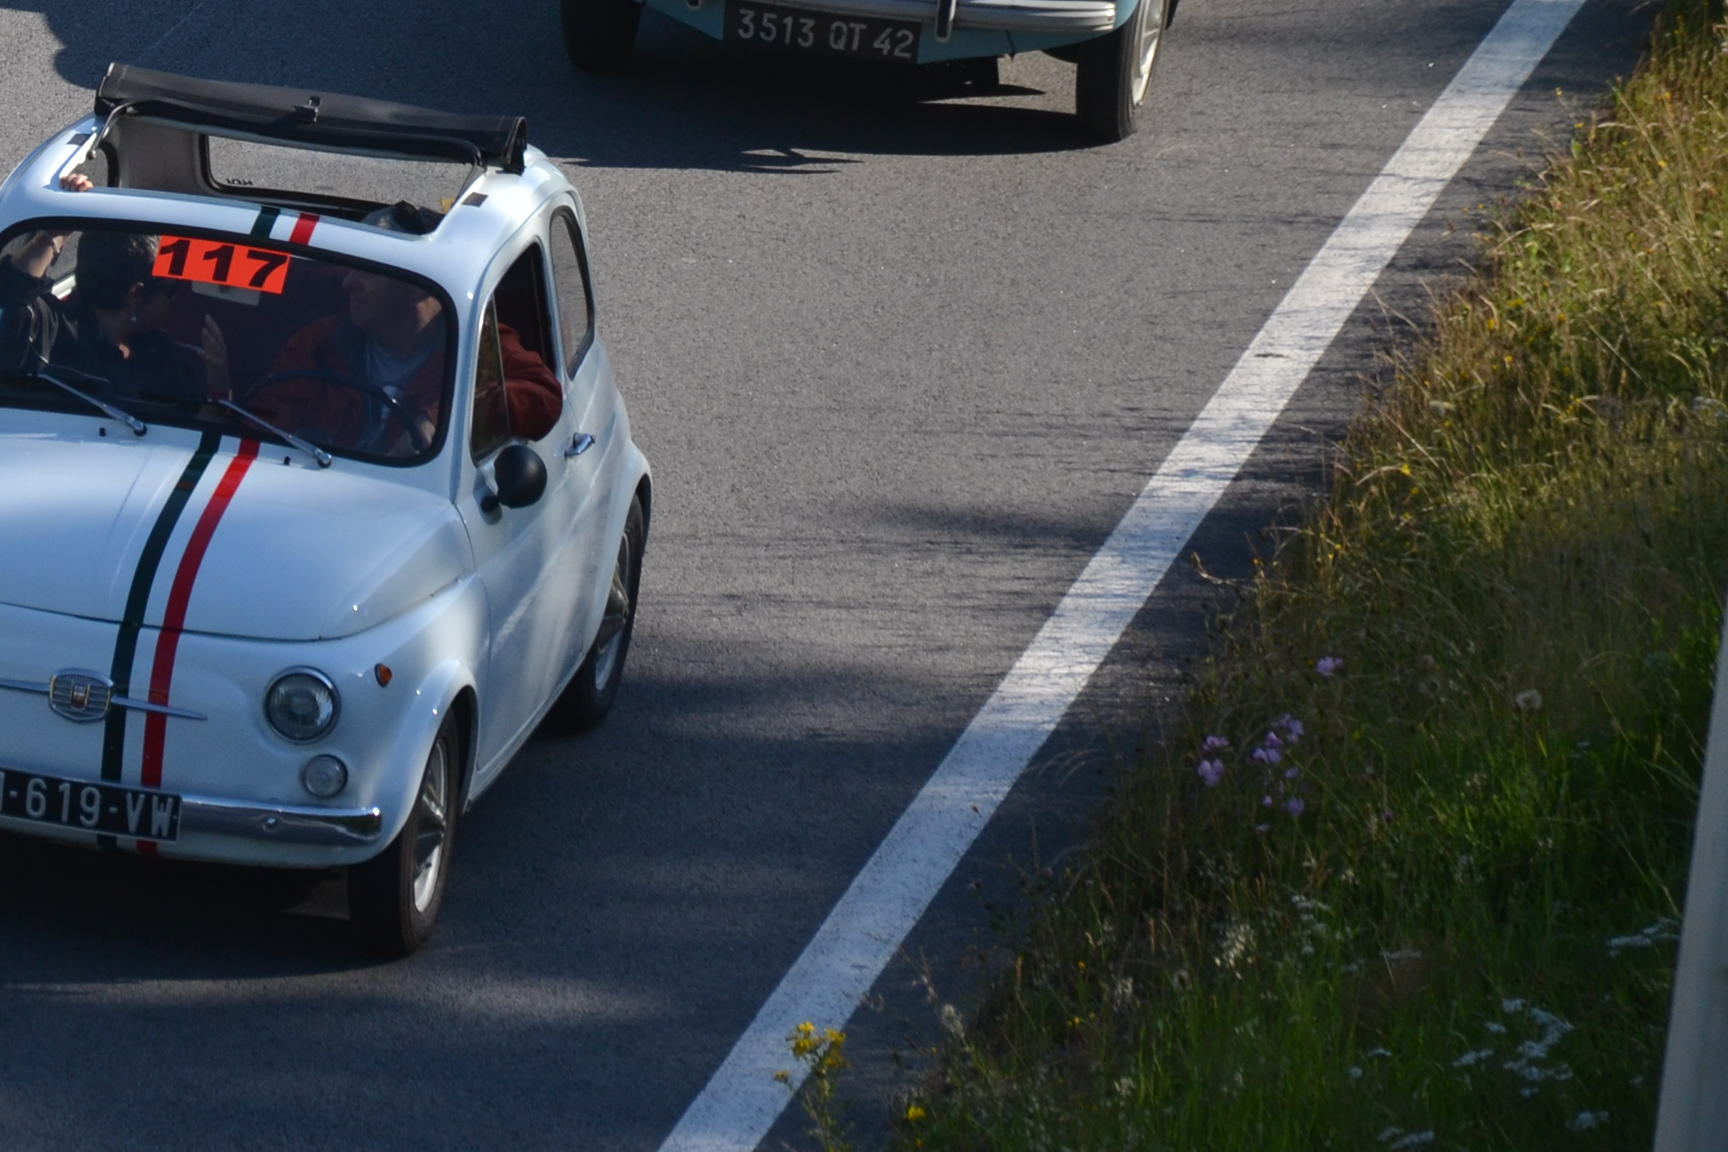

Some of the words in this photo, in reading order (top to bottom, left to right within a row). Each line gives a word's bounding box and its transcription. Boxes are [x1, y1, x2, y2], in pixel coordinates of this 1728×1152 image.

[737, 8, 816, 48] 3513
[829, 21, 867, 51] QT
[873, 27, 915, 58] 42
[159, 239, 288, 289] 117
